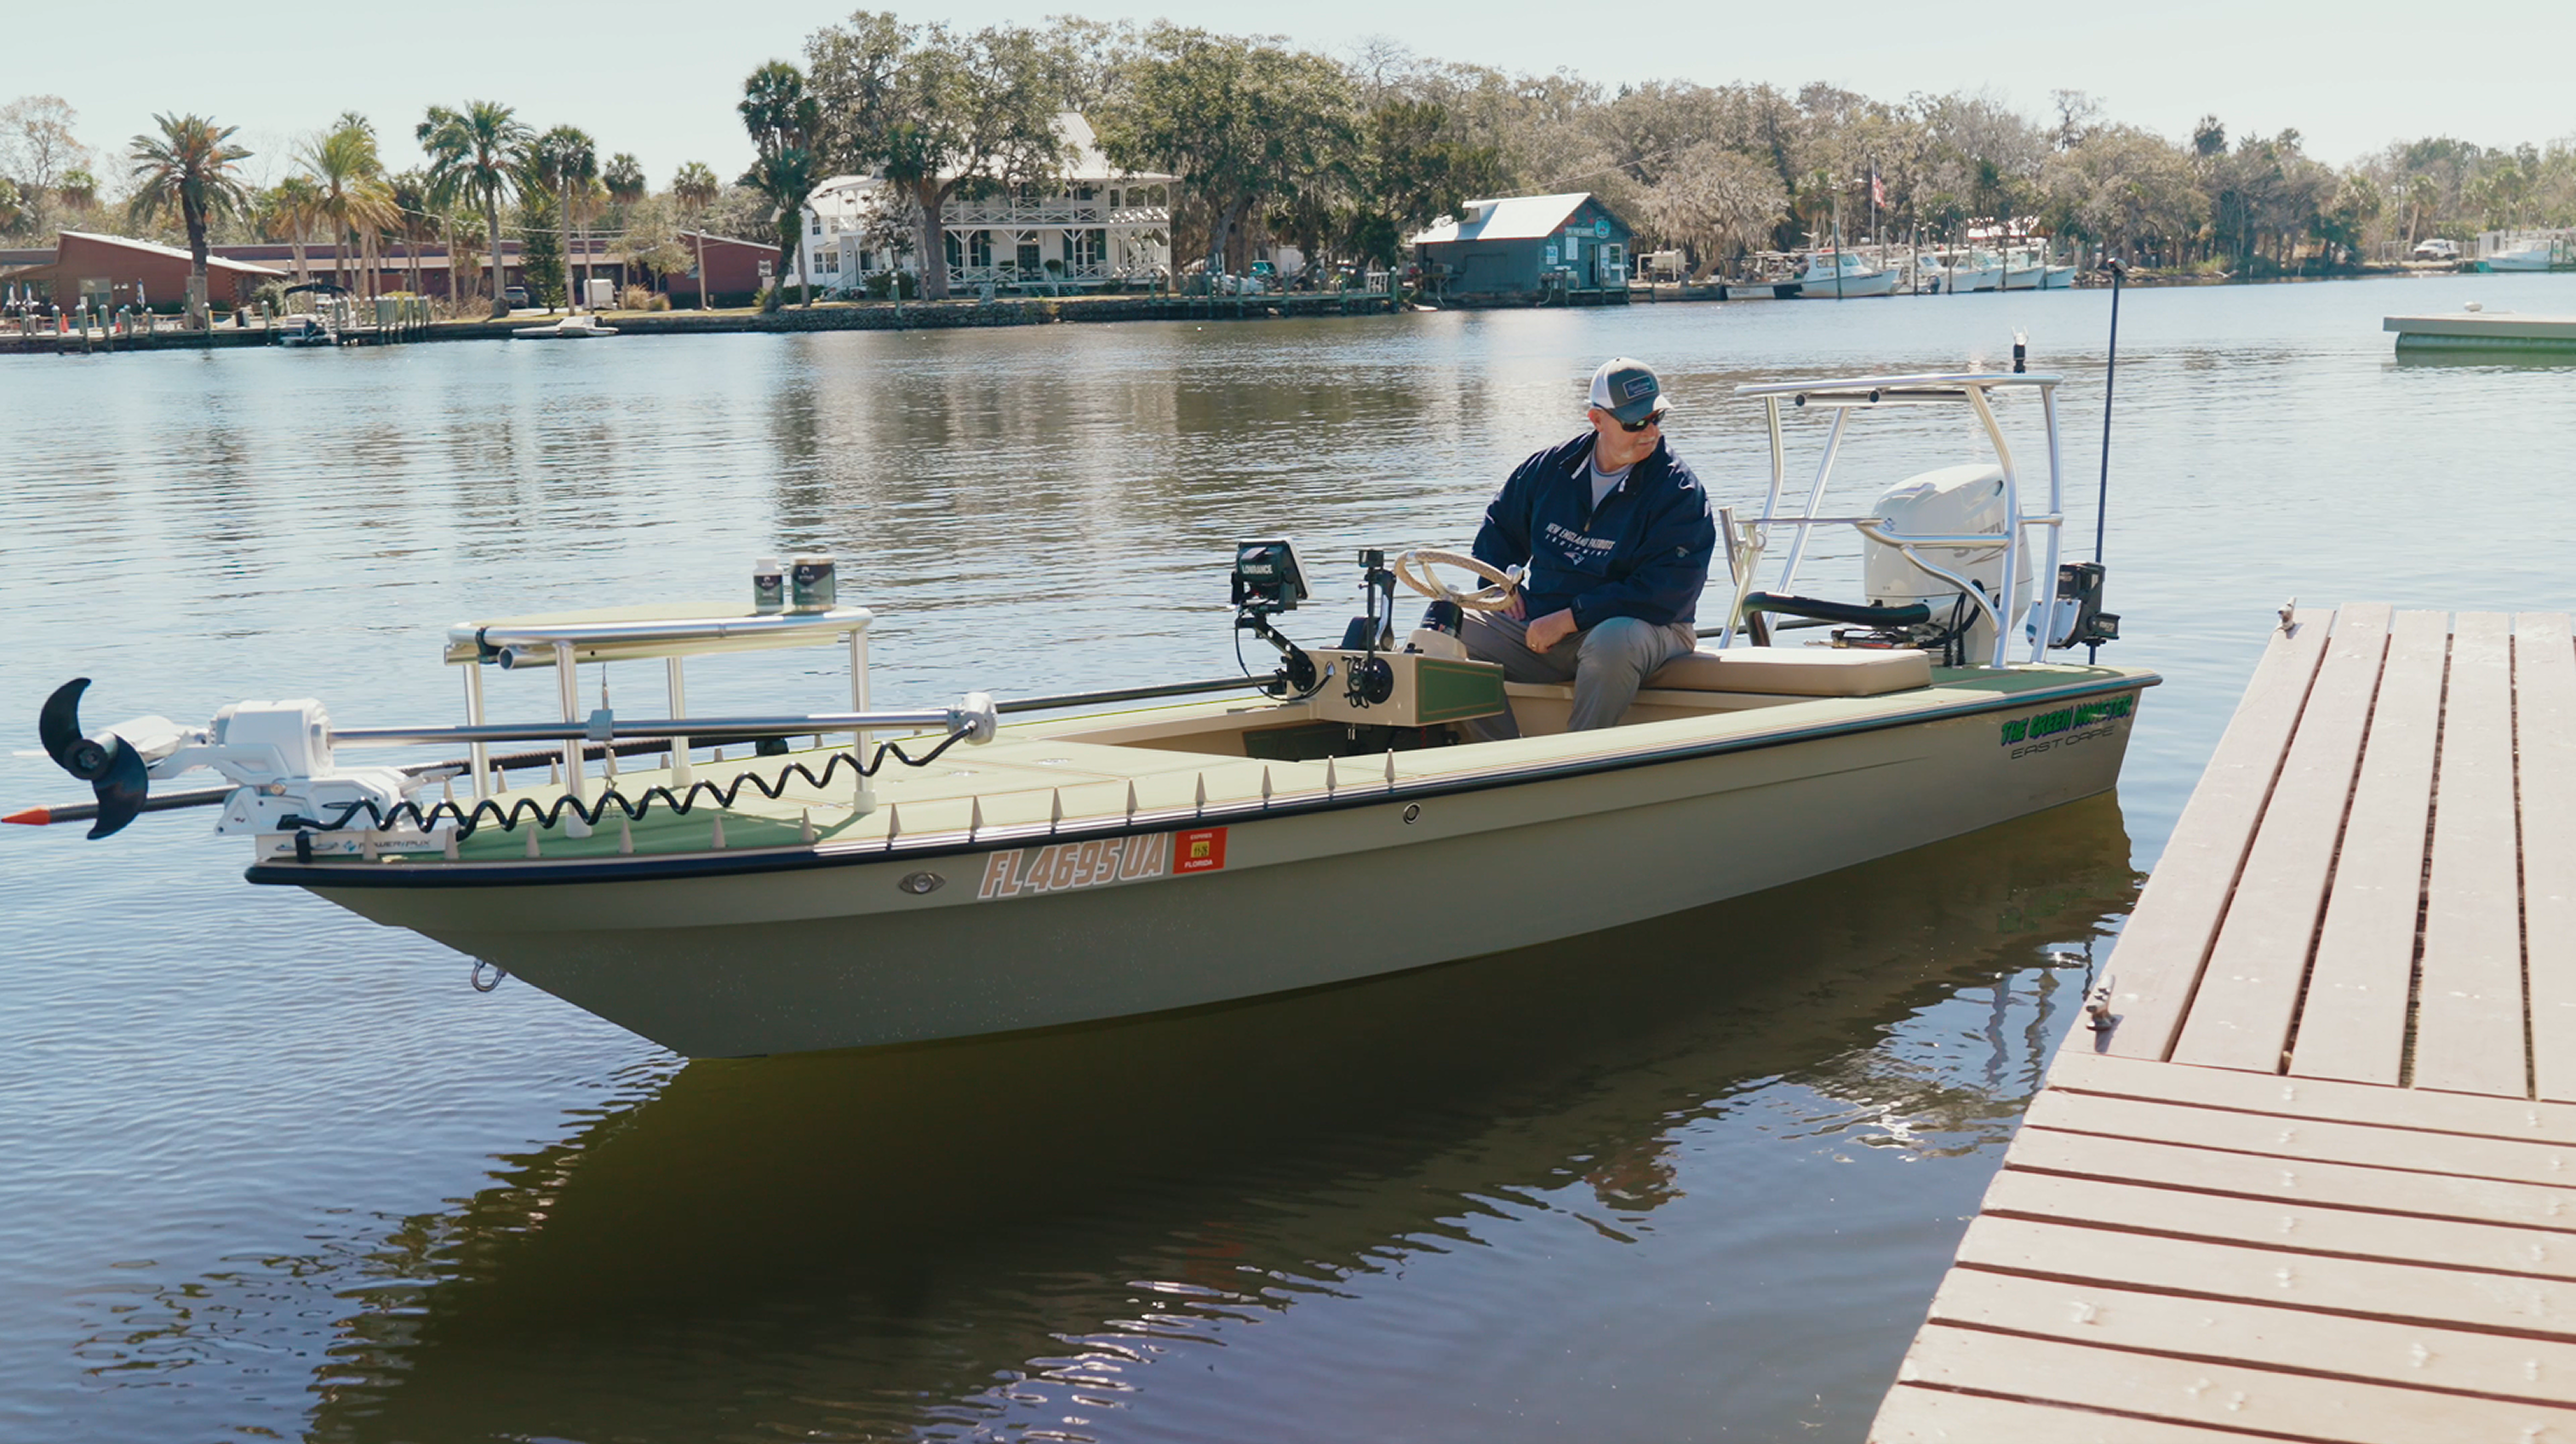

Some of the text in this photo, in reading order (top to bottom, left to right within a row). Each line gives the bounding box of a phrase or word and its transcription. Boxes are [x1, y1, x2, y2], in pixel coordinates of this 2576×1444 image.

[1545, 522, 1616, 550] NEW ENGLAND PATRIOTS
[1242, 564, 1273, 575] LOWRANCE
[2001, 694, 2133, 747] THE GREEN MONSTER
[2011, 725, 2115, 759] EAST CAPE
[977, 832, 1168, 900] FL 4695 UA
[1184, 859, 1213, 868] FLORIDA
